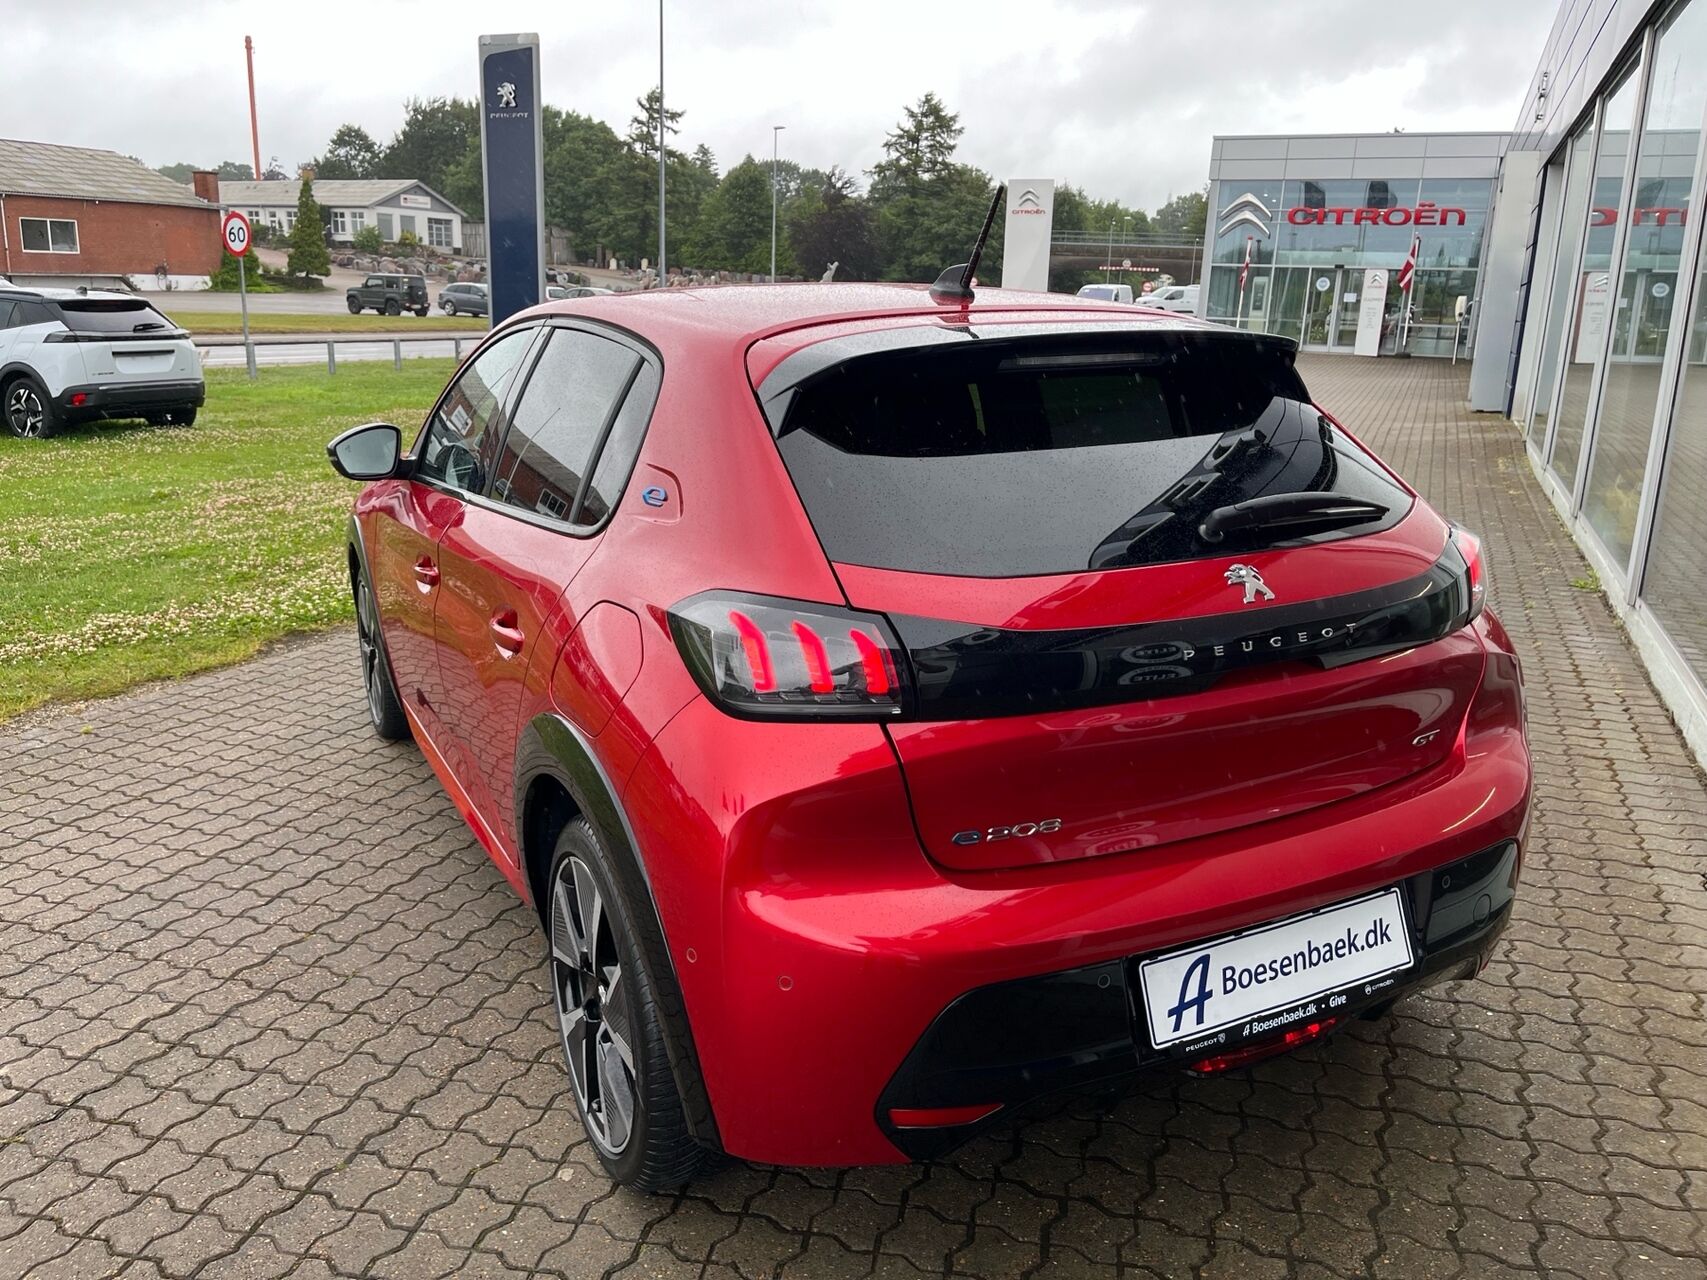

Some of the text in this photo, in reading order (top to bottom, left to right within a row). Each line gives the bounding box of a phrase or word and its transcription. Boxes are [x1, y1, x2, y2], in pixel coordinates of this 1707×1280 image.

[229, 226, 246, 243] 60
[1183, 622, 1356, 661] PEUGEOT
[1412, 729, 1440, 747] GT
[1221, 917, 1392, 996] Boesenbaek.dk
[1252, 1002, 1317, 1034] Boesenbaek.dk
[1329, 994, 1347, 1008] Give
[1186, 1037, 1218, 1052] PEUGEOT
